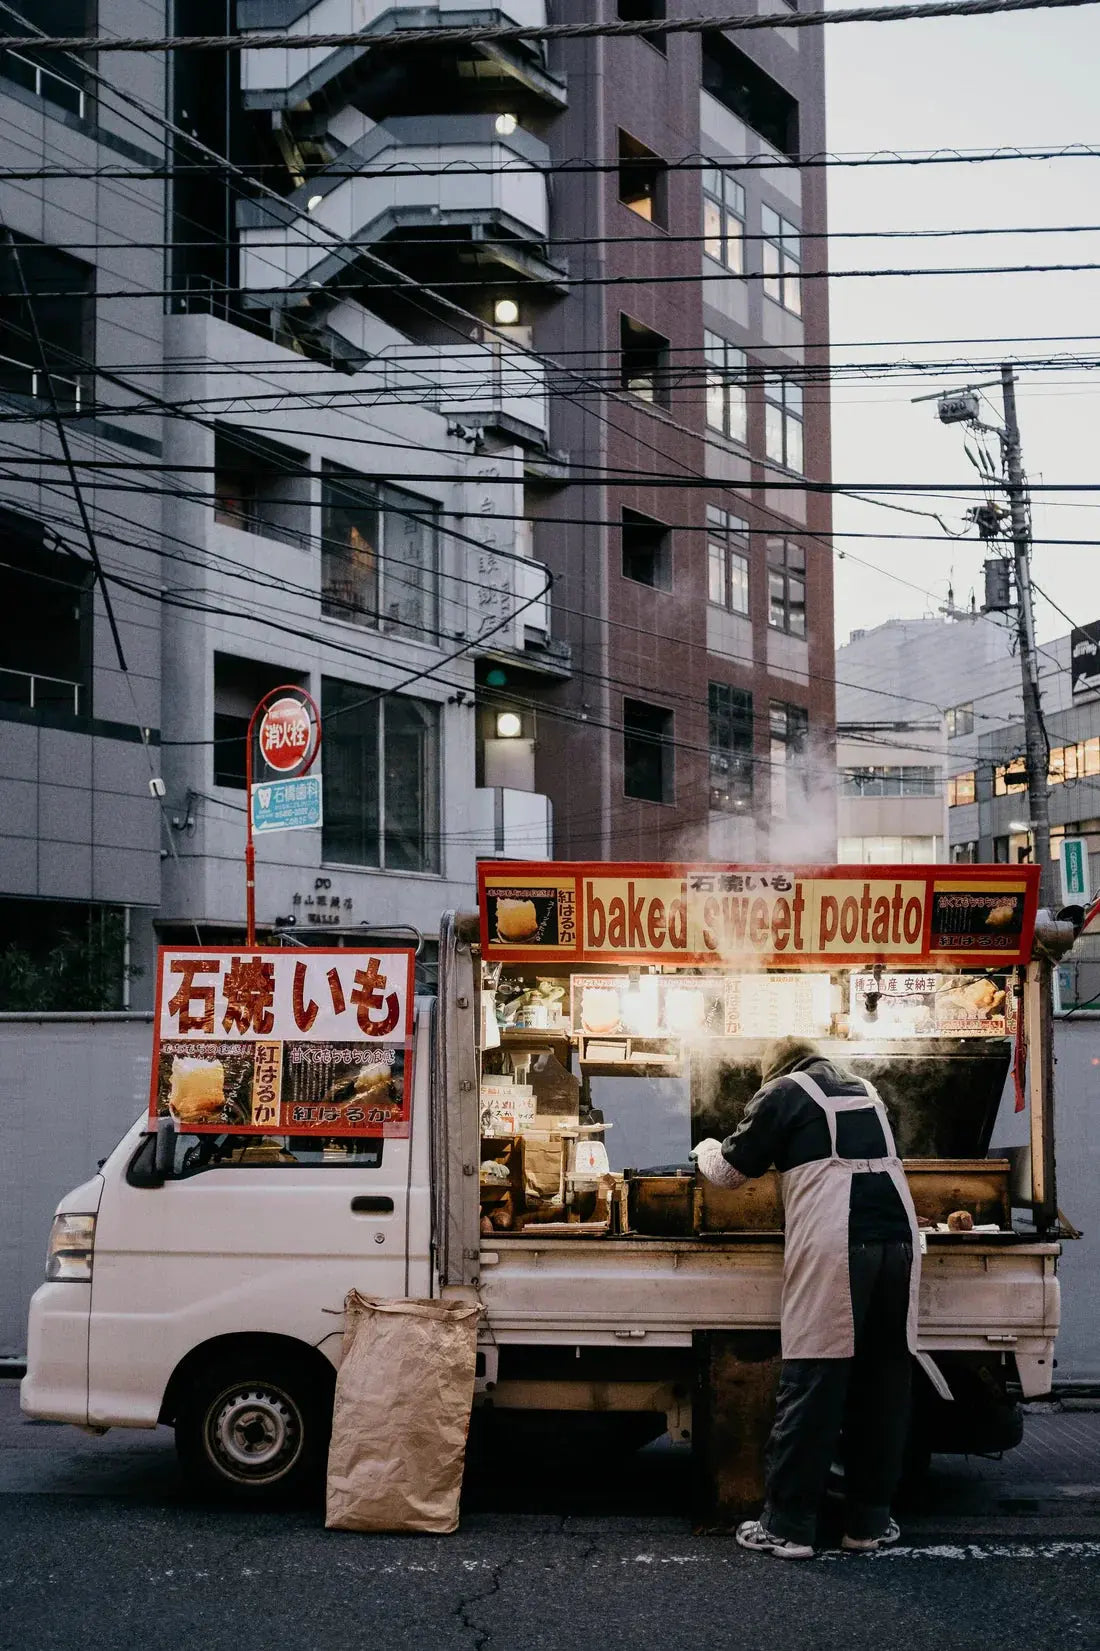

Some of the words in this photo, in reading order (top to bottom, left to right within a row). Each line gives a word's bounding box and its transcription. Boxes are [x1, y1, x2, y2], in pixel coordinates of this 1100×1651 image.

[265, 721, 306, 750] 消火栓
[274, 781, 318, 803] 石橋歯科
[690, 874, 792, 893] 石焼いも
[558, 890, 576, 943] 紅はるか
[586, 881, 687, 950] baked
[703, 882, 805, 951] sweet
[819, 883, 922, 951] potato
[938, 935, 1012, 947] 紅はるか
[904, 977, 936, 991] 安納芋
[167, 956, 400, 1037] 石焼いも
[291, 1047, 396, 1066] 甘くてもちもちの食感
[254, 1045, 280, 1124] 紅はるか
[292, 1105, 392, 1123] 紅はるか
